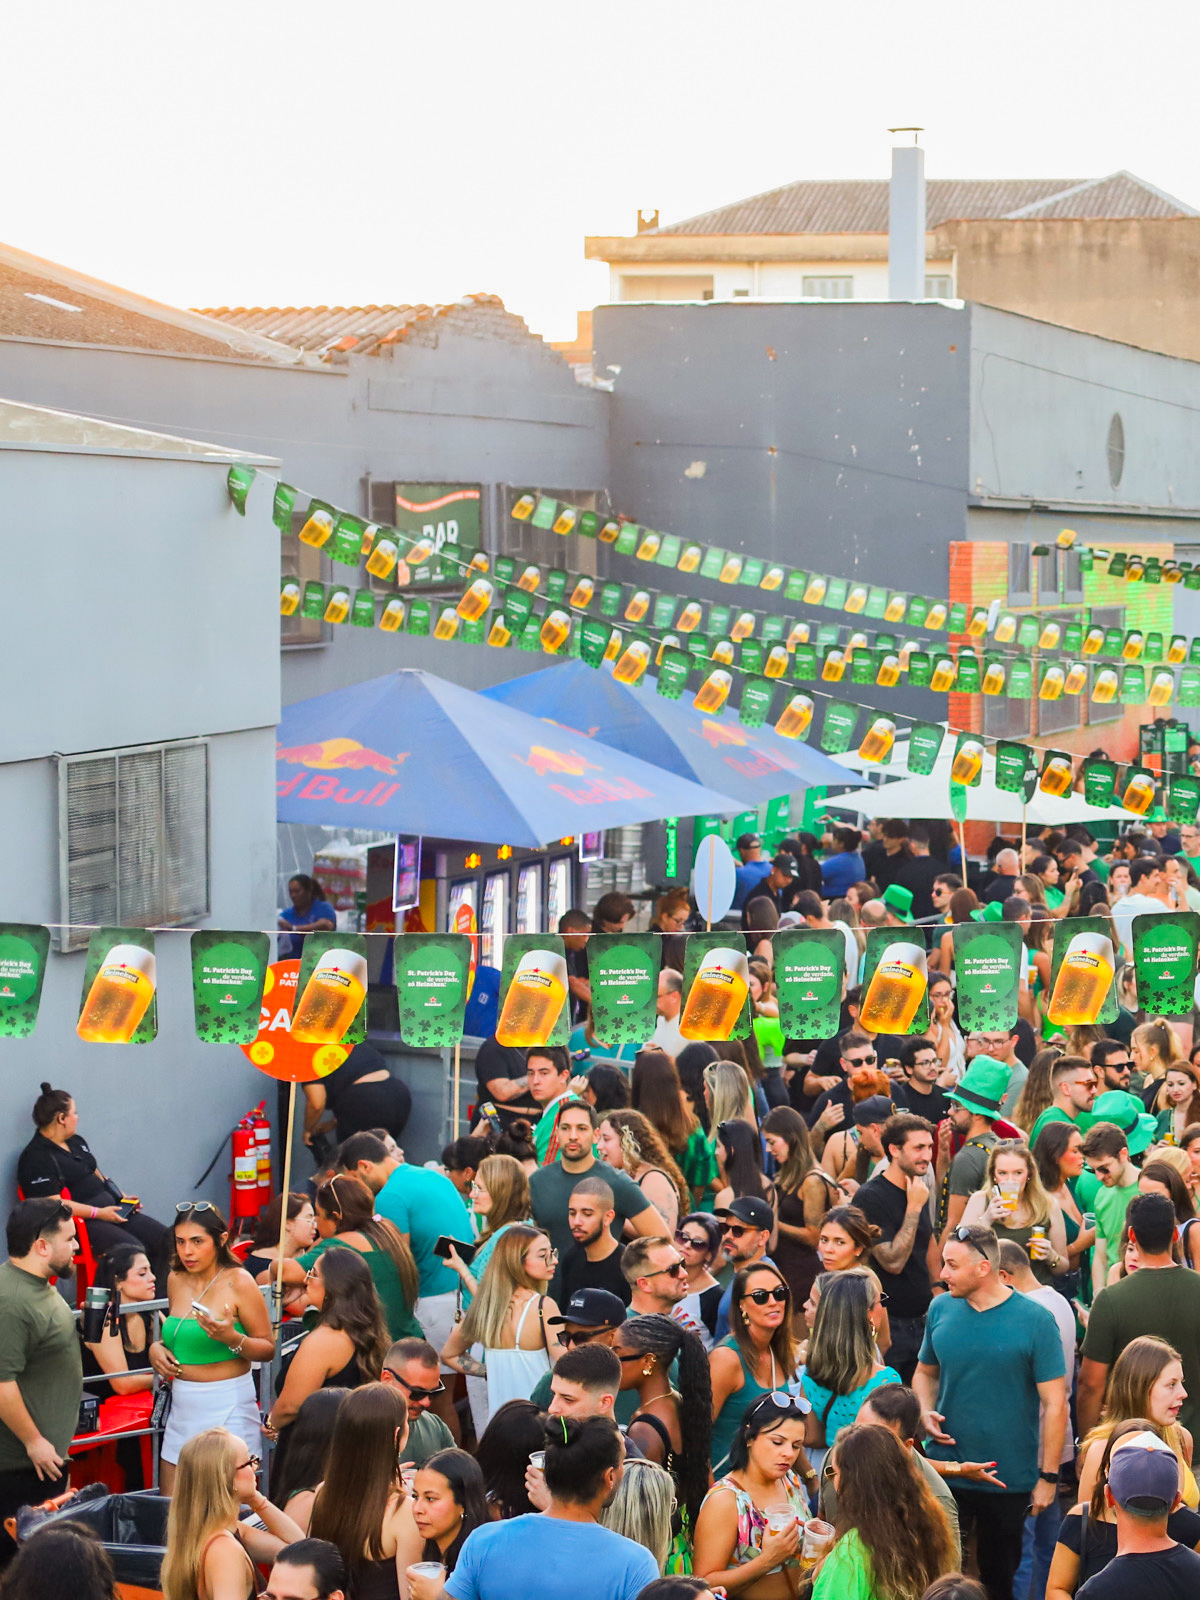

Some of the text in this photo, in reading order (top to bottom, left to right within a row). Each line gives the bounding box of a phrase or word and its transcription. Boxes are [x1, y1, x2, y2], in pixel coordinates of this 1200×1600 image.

[297, 774, 402, 806] Bull
[1069, 956, 1097, 967] Heineken
[104, 970, 137, 982] Heineken
[882, 967, 911, 977] Heineken
[317, 973, 349, 985] Heineken
[519, 975, 550, 986] Heineken
[702, 973, 732, 983] Heineken
